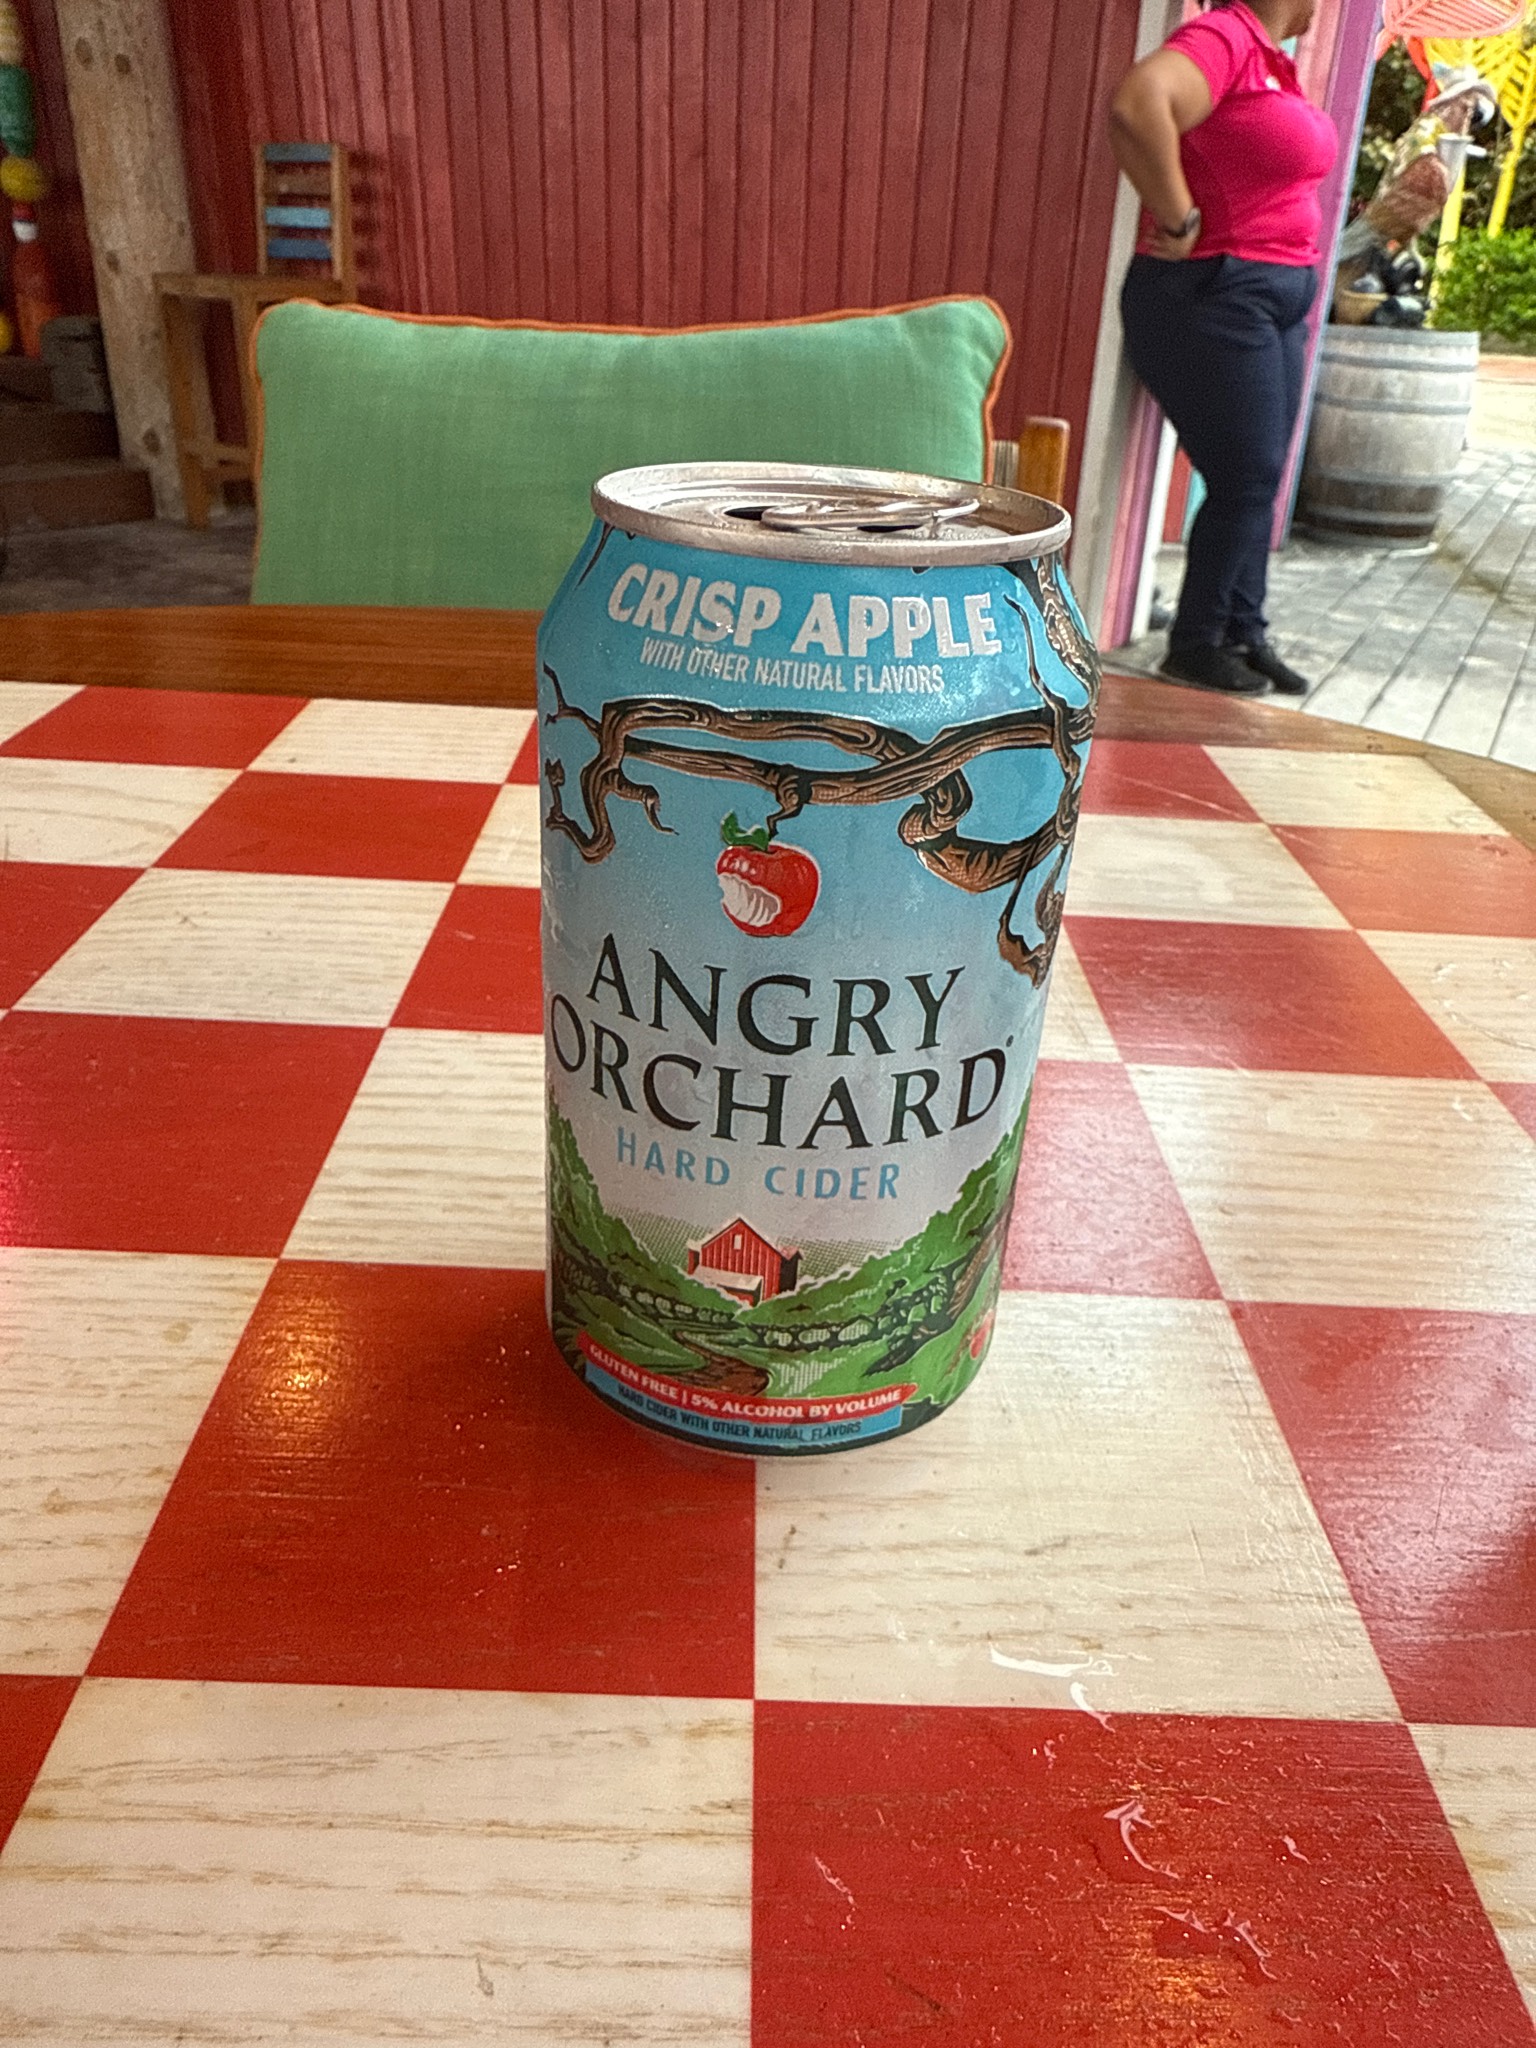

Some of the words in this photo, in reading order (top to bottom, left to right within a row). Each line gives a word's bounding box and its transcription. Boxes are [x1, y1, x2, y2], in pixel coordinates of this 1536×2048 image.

[606, 563, 781, 647] CRISP
[790, 591, 1001, 659] APPLE
[639, 636, 686, 673] WITH
[687, 647, 750, 683] OTHER
[752, 658, 845, 693] NATURAL
[853, 663, 946, 695] FLAVORS
[586, 932, 967, 1057] ANGRY
[551, 992, 1007, 1151] ORCHARD
[616, 1126, 731, 1187] HARD
[764, 1162, 901, 1201] CIDER
[589, 1344, 639, 1383] GLUTEN
[641, 1375, 678, 1400] FREE
[691, 1394, 718, 1411] 5%
[721, 1401, 804, 1418] ALCOHOL
[809, 1403, 831, 1418] BY
[835, 1388, 902, 1415] VOLUME
[617, 1383, 644, 1407] HARD
[646, 1397, 677, 1421] CIDER
[680, 1411, 709, 1431] WITH
[712, 1421, 750, 1437] OTHER
[753, 1427, 805, 1442] NATURAL
[811, 1421, 862, 1441] FLAVORS
